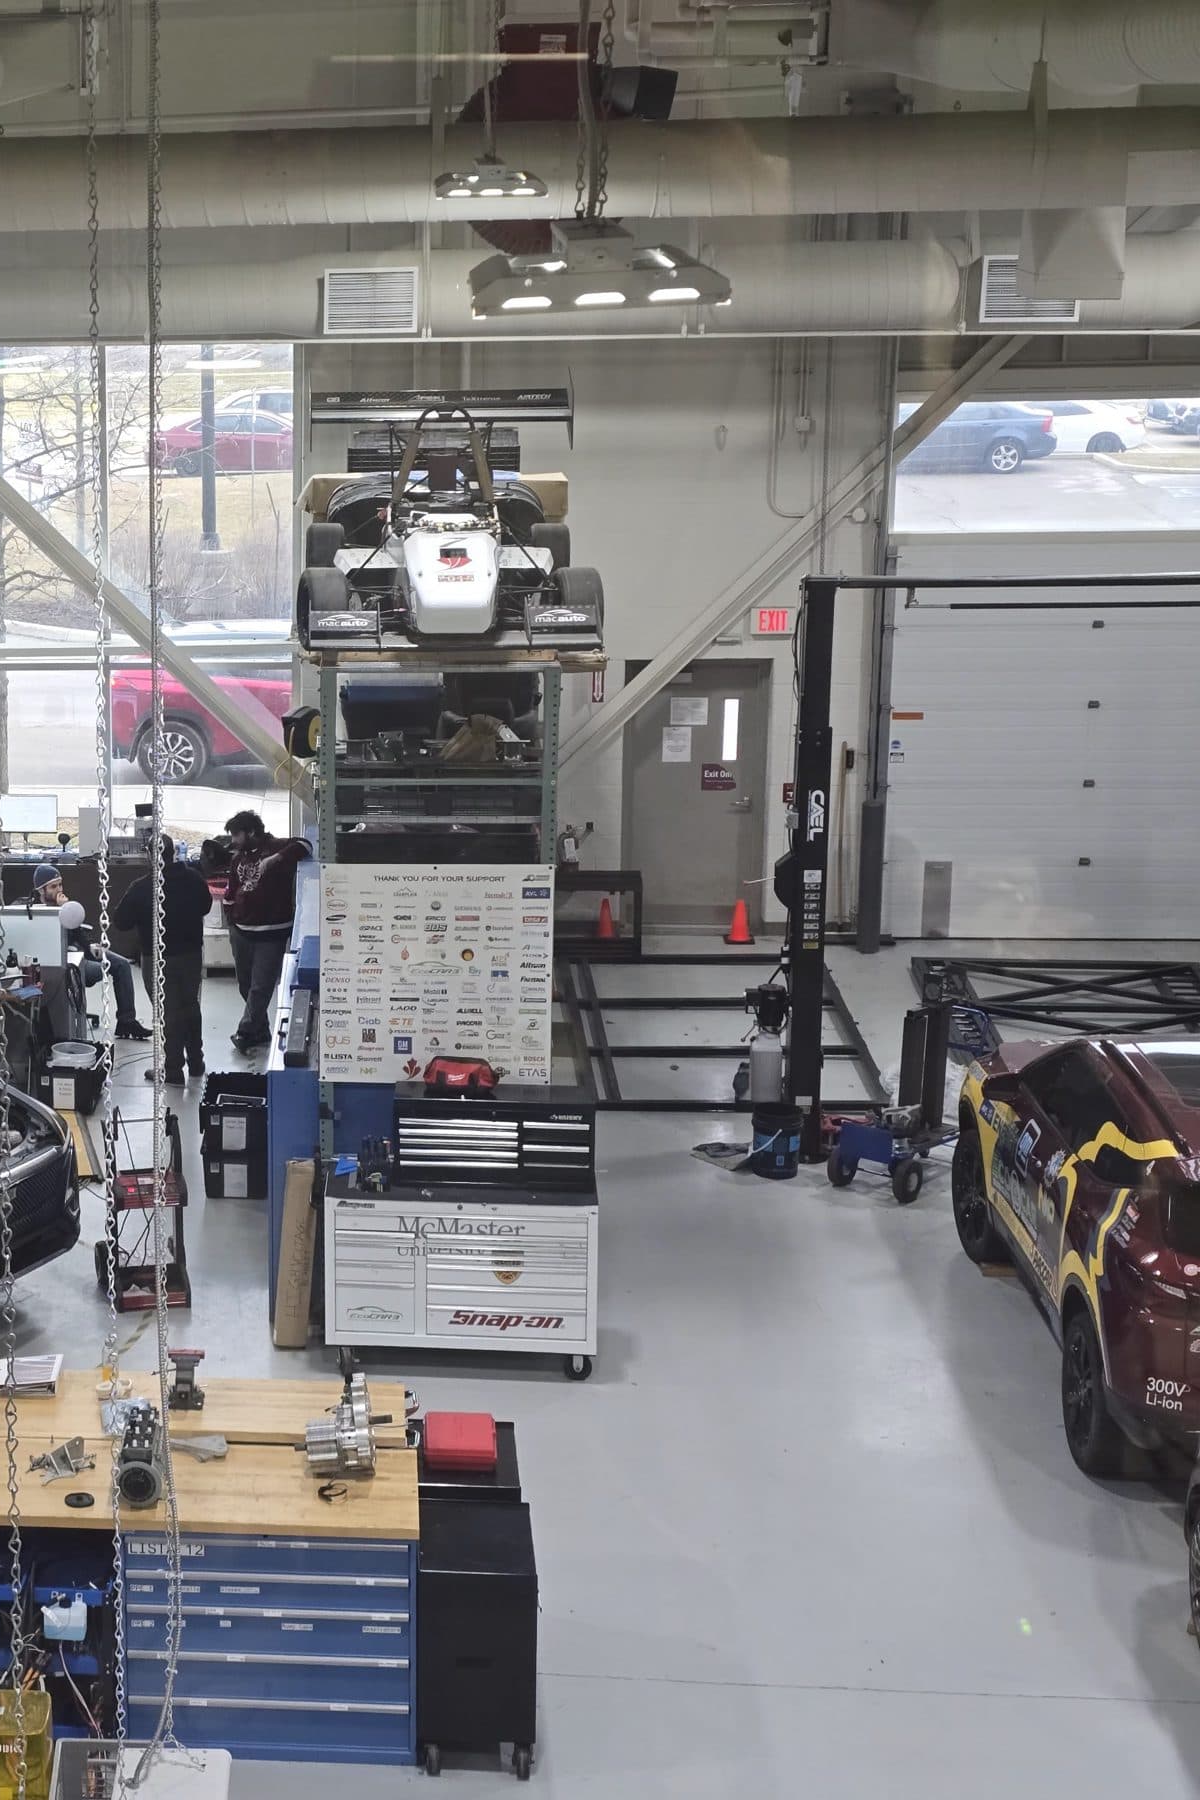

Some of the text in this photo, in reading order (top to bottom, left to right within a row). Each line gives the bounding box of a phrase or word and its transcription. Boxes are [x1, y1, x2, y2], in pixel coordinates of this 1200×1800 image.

[759, 610, 788, 631] EXIT
[704, 770, 718, 778] Exit
[519, 1068, 547, 1077] ETAS
[397, 1215, 526, 1238] McMaster
[448, 1309, 564, 1331] Snap-on
[1146, 1377, 1186, 1397] 300V
[1145, 1391, 1183, 1411] Li-ion
[186, 1543, 203, 1555] 12
